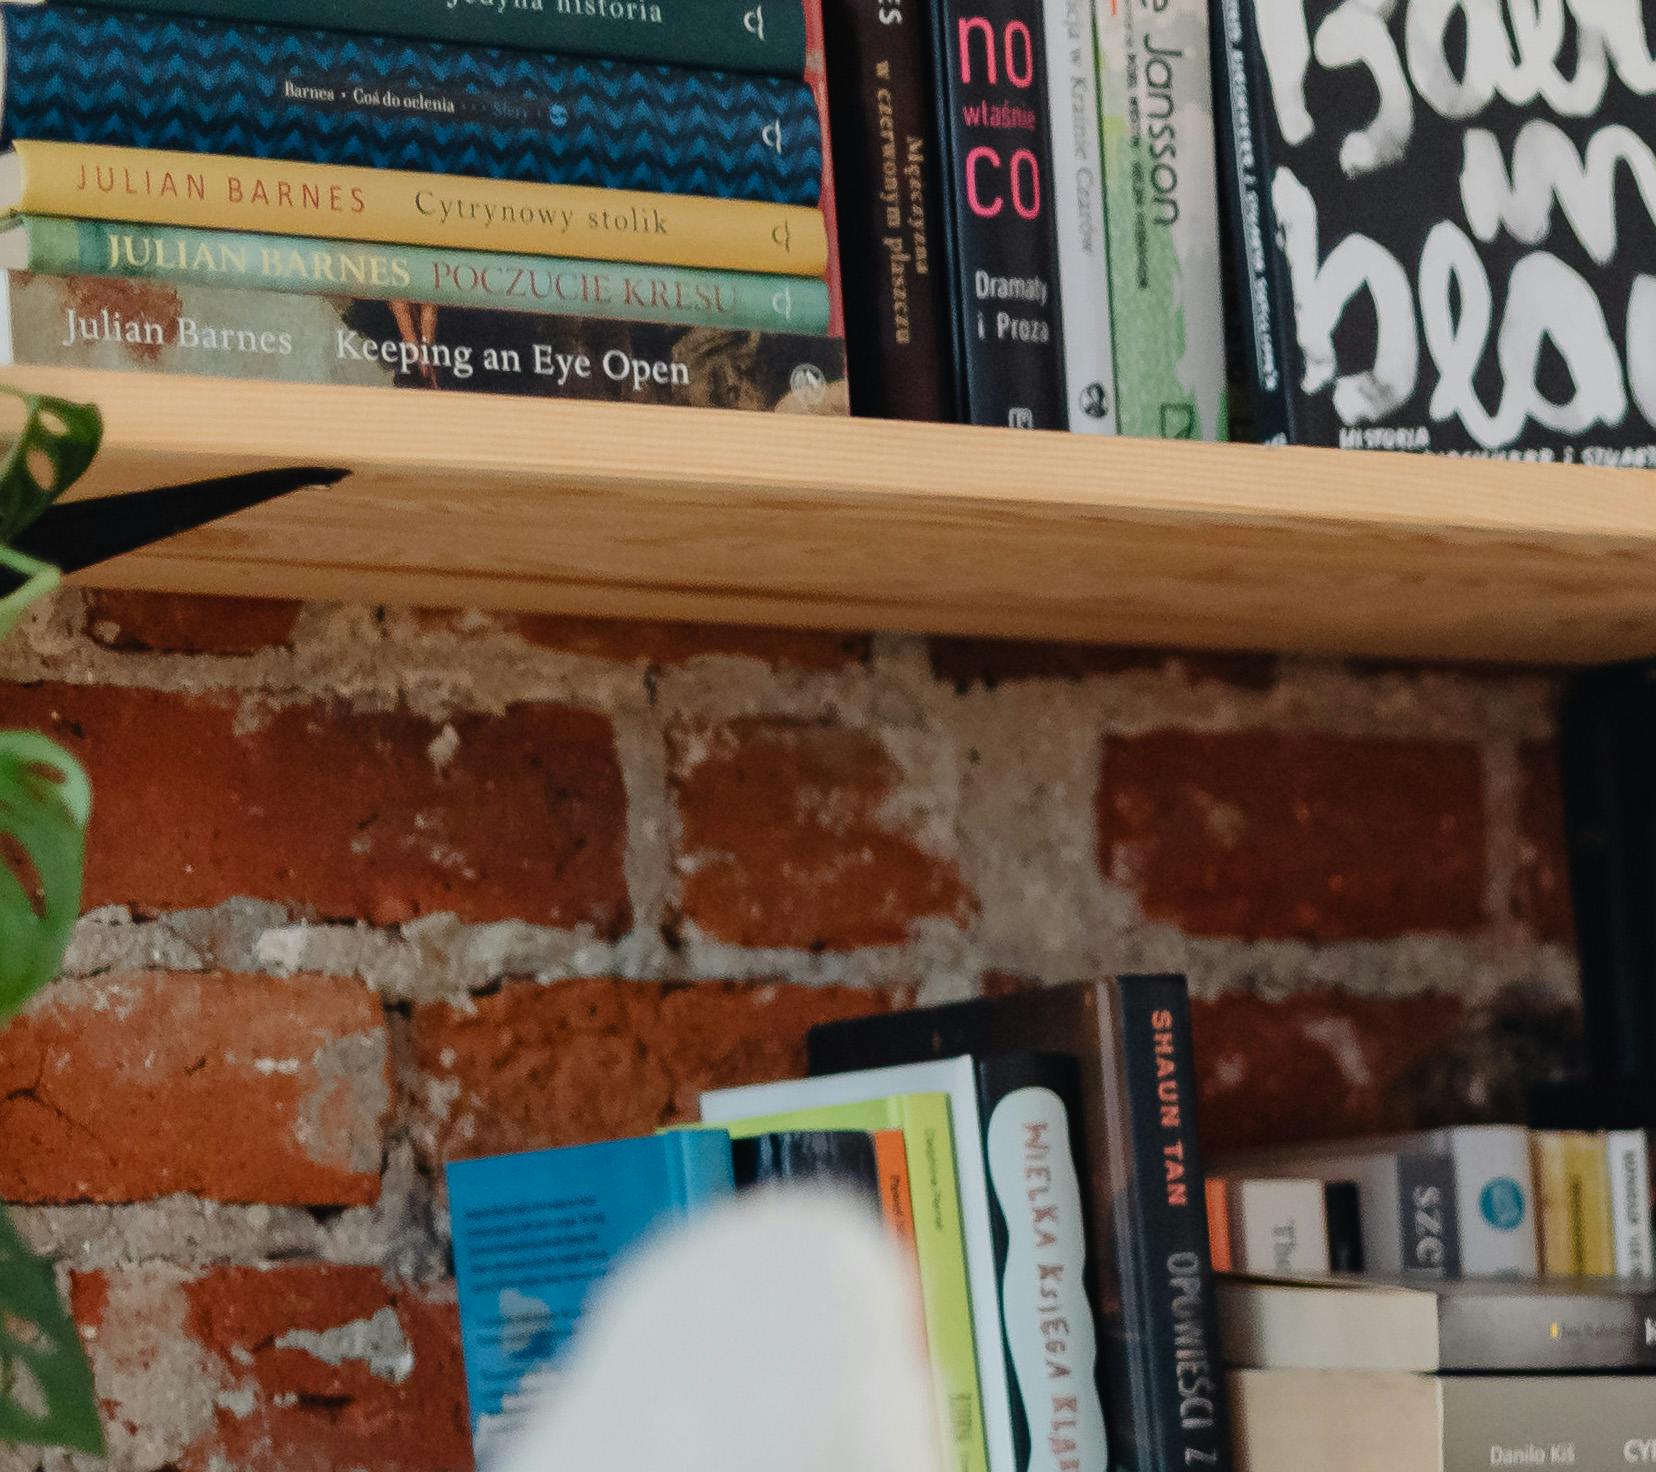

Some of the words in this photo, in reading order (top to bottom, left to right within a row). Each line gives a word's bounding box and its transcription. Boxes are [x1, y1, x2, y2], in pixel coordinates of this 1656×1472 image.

[958, 16, 1033, 88] no
[284, 81, 335, 101] Barnes
[383, 91, 400, 108] do
[1143, 33, 1183, 227] Jansson
[77, 165, 205, 201] JULIAN
[228, 176, 365, 213] BARNES
[415, 190, 574, 234] Cytrynowy
[588, 206, 668, 235] stolik
[965, 146, 1040, 219] co
[106, 234, 245, 273] JULIAN
[261, 246, 411, 288] BARNES
[432, 261, 610, 302] POCZUCIE
[623, 278, 738, 313] KRESU
[975, 270, 1047, 306] Dramaty
[62, 308, 166, 347] Julian
[177, 317, 292, 355] Barnes
[335, 329, 472, 379] Keeping
[484, 349, 520, 373] an
[533, 343, 591, 386] Eye
[603, 349, 690, 391] Open
[977, 312, 985, 342] i
[997, 311, 1049, 344] Proza
[1151, 1009, 1181, 1129] SHAUN
[1023, 1120, 1060, 1250] WIELKA
[1162, 1137, 1188, 1207] TAN
[1166, 1251, 1216, 1431] OPOWIEŚCI
[1490, 1444, 1547, 1466] Danilo
